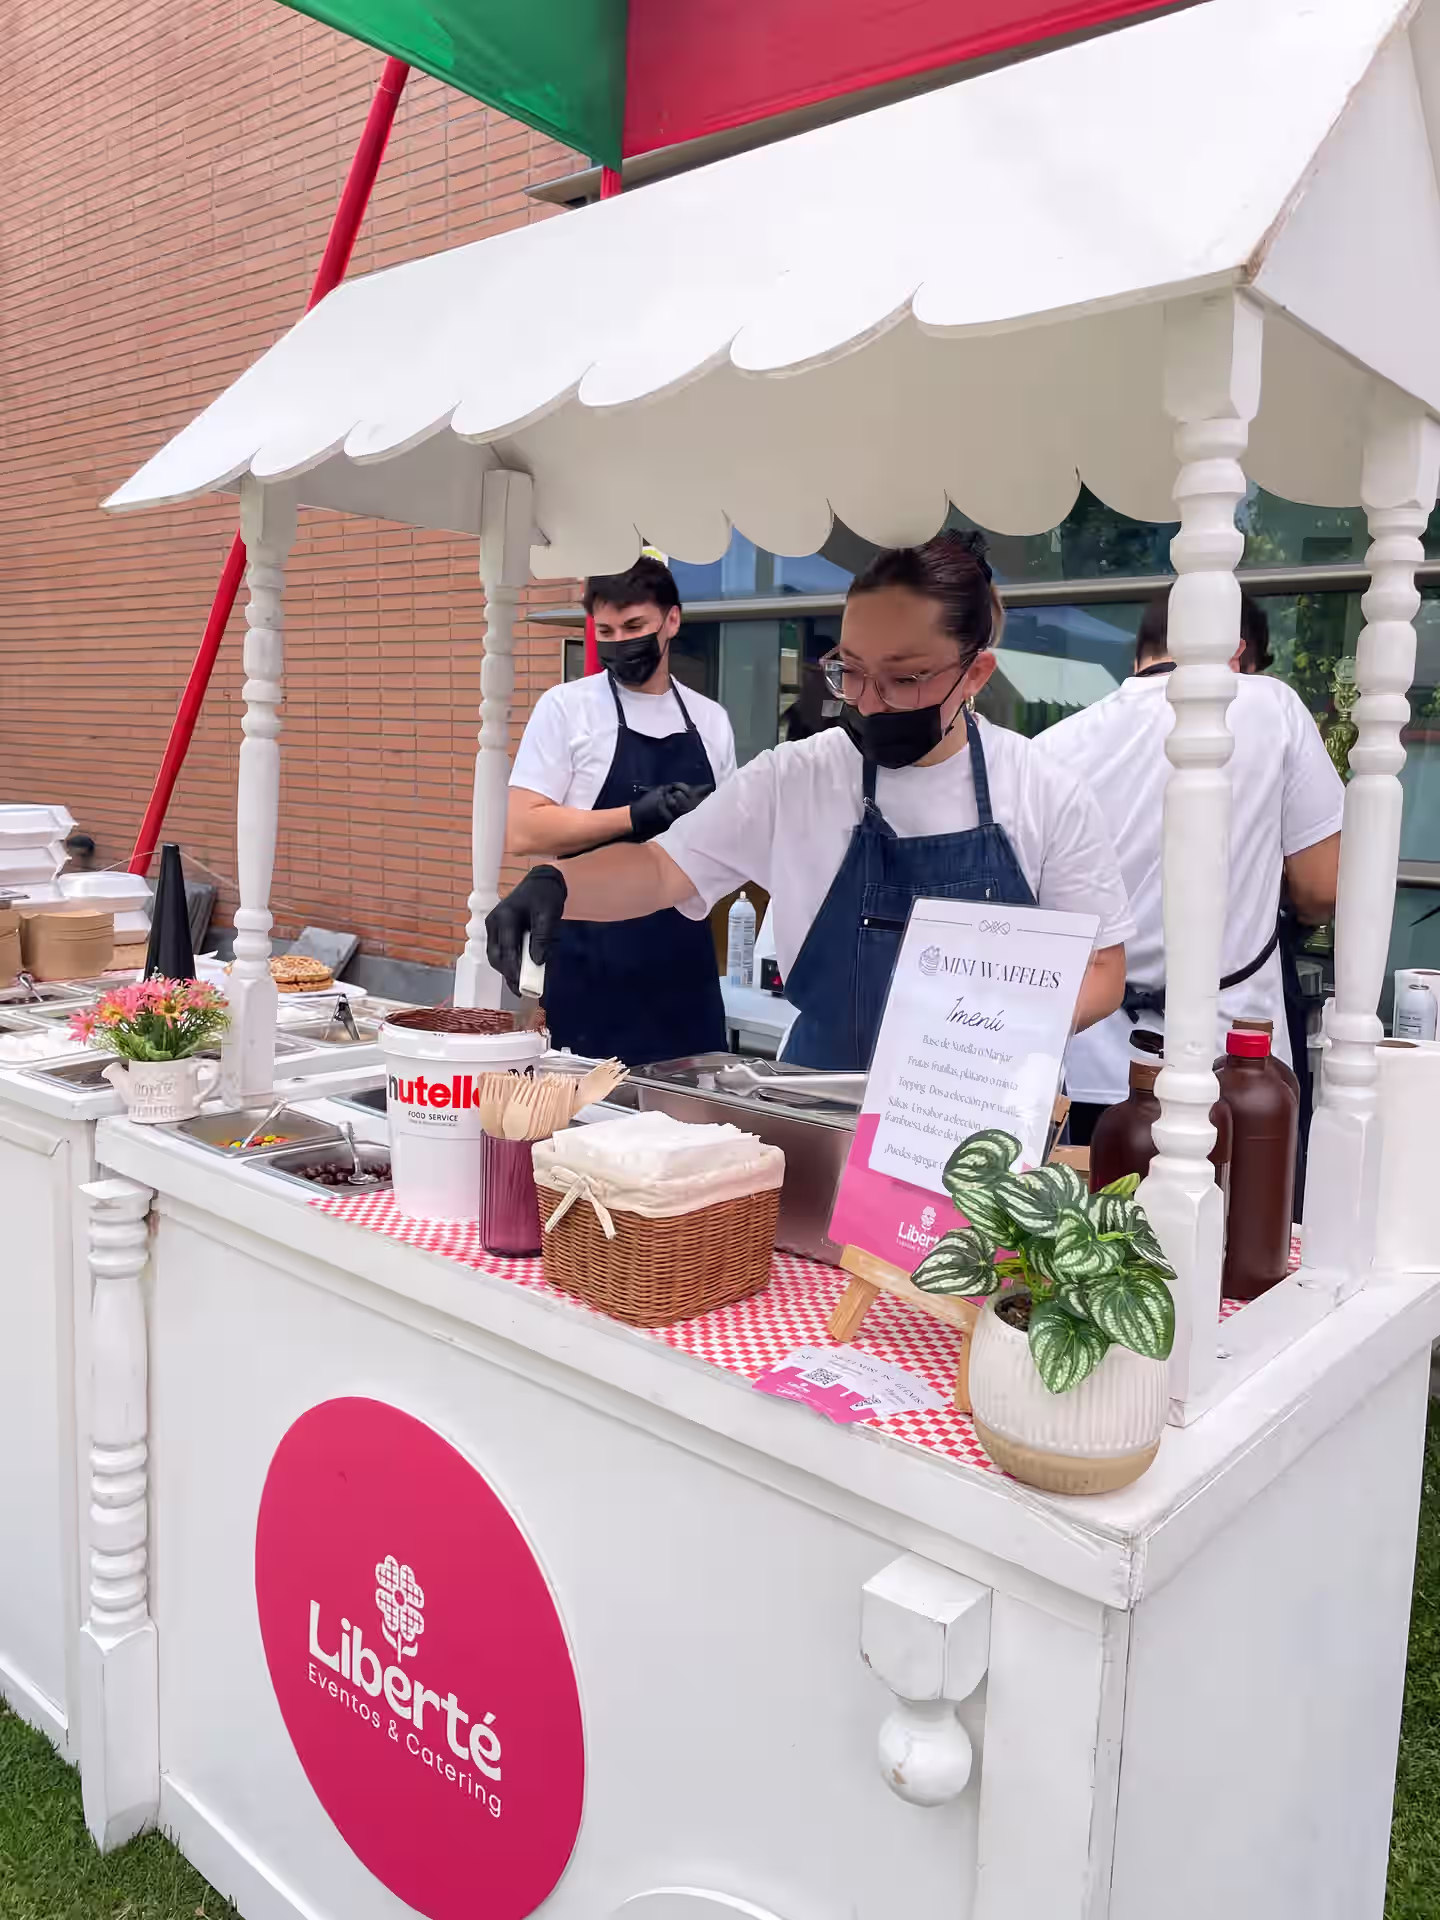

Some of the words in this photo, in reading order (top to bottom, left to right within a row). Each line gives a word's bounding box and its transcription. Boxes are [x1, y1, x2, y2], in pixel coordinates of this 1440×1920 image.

[940, 956, 977, 977] MINI
[981, 960, 1062, 989] WAFFLES
[408, 1110, 426, 1120] FOOD
[428, 1113, 459, 1122] SERVICE
[898, 1221, 940, 1249] Libert
[309, 1599, 501, 1781] Liberté
[308, 1662, 381, 1729] Eventos
[387, 1718, 399, 1743] &
[406, 1732, 501, 1818] Catering
